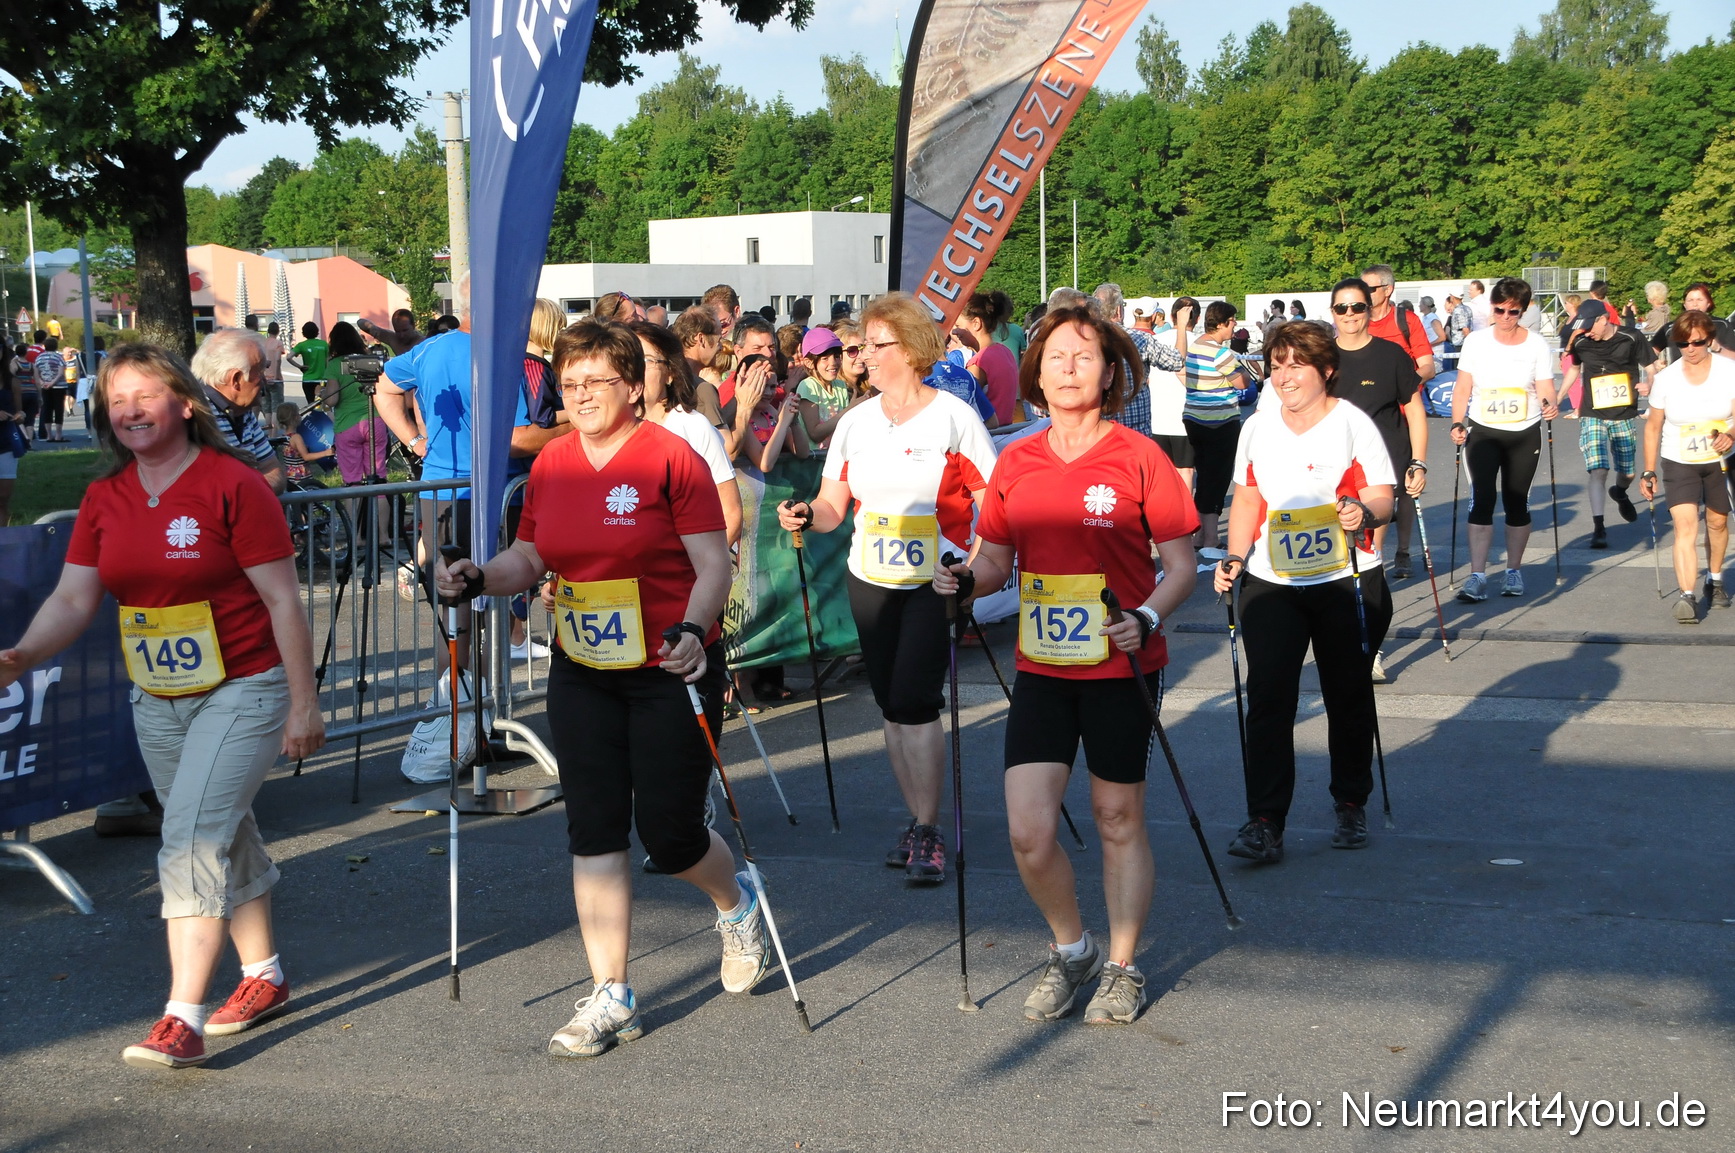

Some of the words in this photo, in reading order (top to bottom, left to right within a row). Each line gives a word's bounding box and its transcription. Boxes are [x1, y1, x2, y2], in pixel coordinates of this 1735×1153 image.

[918, 0, 1113, 324] ECHSELSZENE.
[1594, 385, 1628, 401] 1132
[1487, 400, 1519, 415] 415
[303, 419, 322, 438] EURO
[1687, 435, 1713, 452] 41
[604, 516, 637, 526] caritas
[1083, 516, 1114, 529] caritas
[873, 537, 925, 567] 126
[1279, 527, 1333, 559] 125
[166, 549, 201, 559] caritas
[564, 610, 628, 648] 154
[1029, 605, 1091, 642] 152
[135, 636, 203, 674] 149
